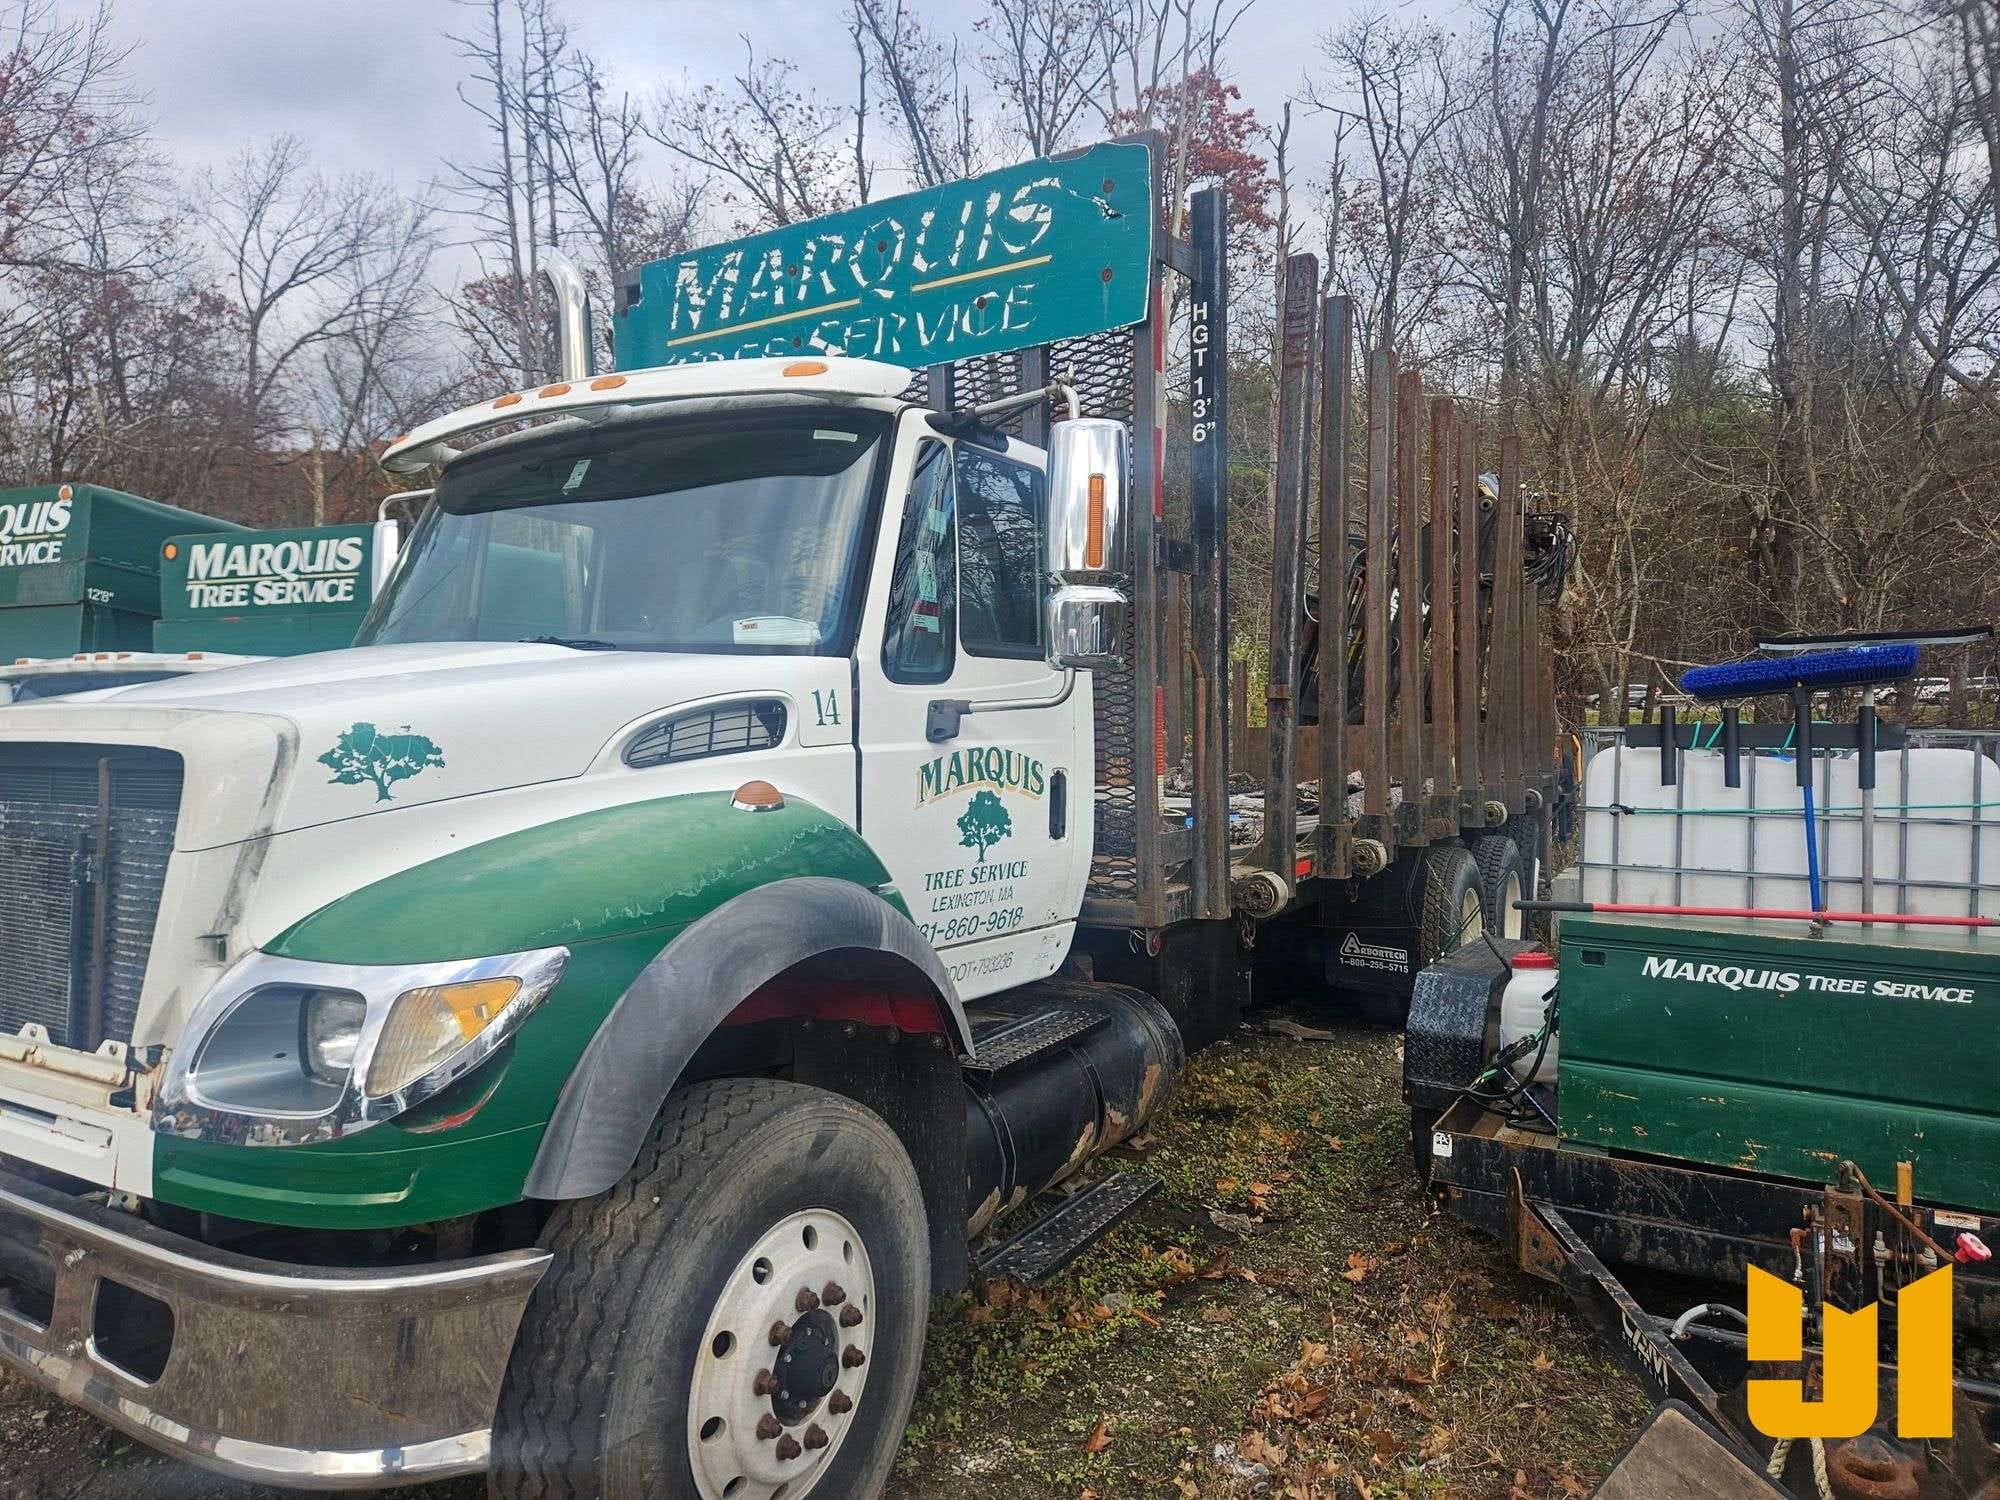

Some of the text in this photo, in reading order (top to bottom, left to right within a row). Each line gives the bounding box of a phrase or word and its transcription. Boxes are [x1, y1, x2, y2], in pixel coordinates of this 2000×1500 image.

[670, 176, 1062, 331] MARQUIS
[808, 283, 1039, 358] SERVICE
[1192, 301, 1209, 367] HGT
[187, 536, 363, 582] MARQUIS
[185, 578, 356, 609] TREE SERVICE
[811, 688, 841, 726] 14
[919, 745, 1045, 803] MARQUIS
[924, 860, 1028, 892] TREE SERVICE
[916, 906, 1024, 944] 81-860-9618
[1340, 957, 1409, 974] 1-800-255-5715
[1344, 936, 1405, 960] ARBORTECH
[1641, 956, 1975, 1004] MARQUIS TREE SERVICE
